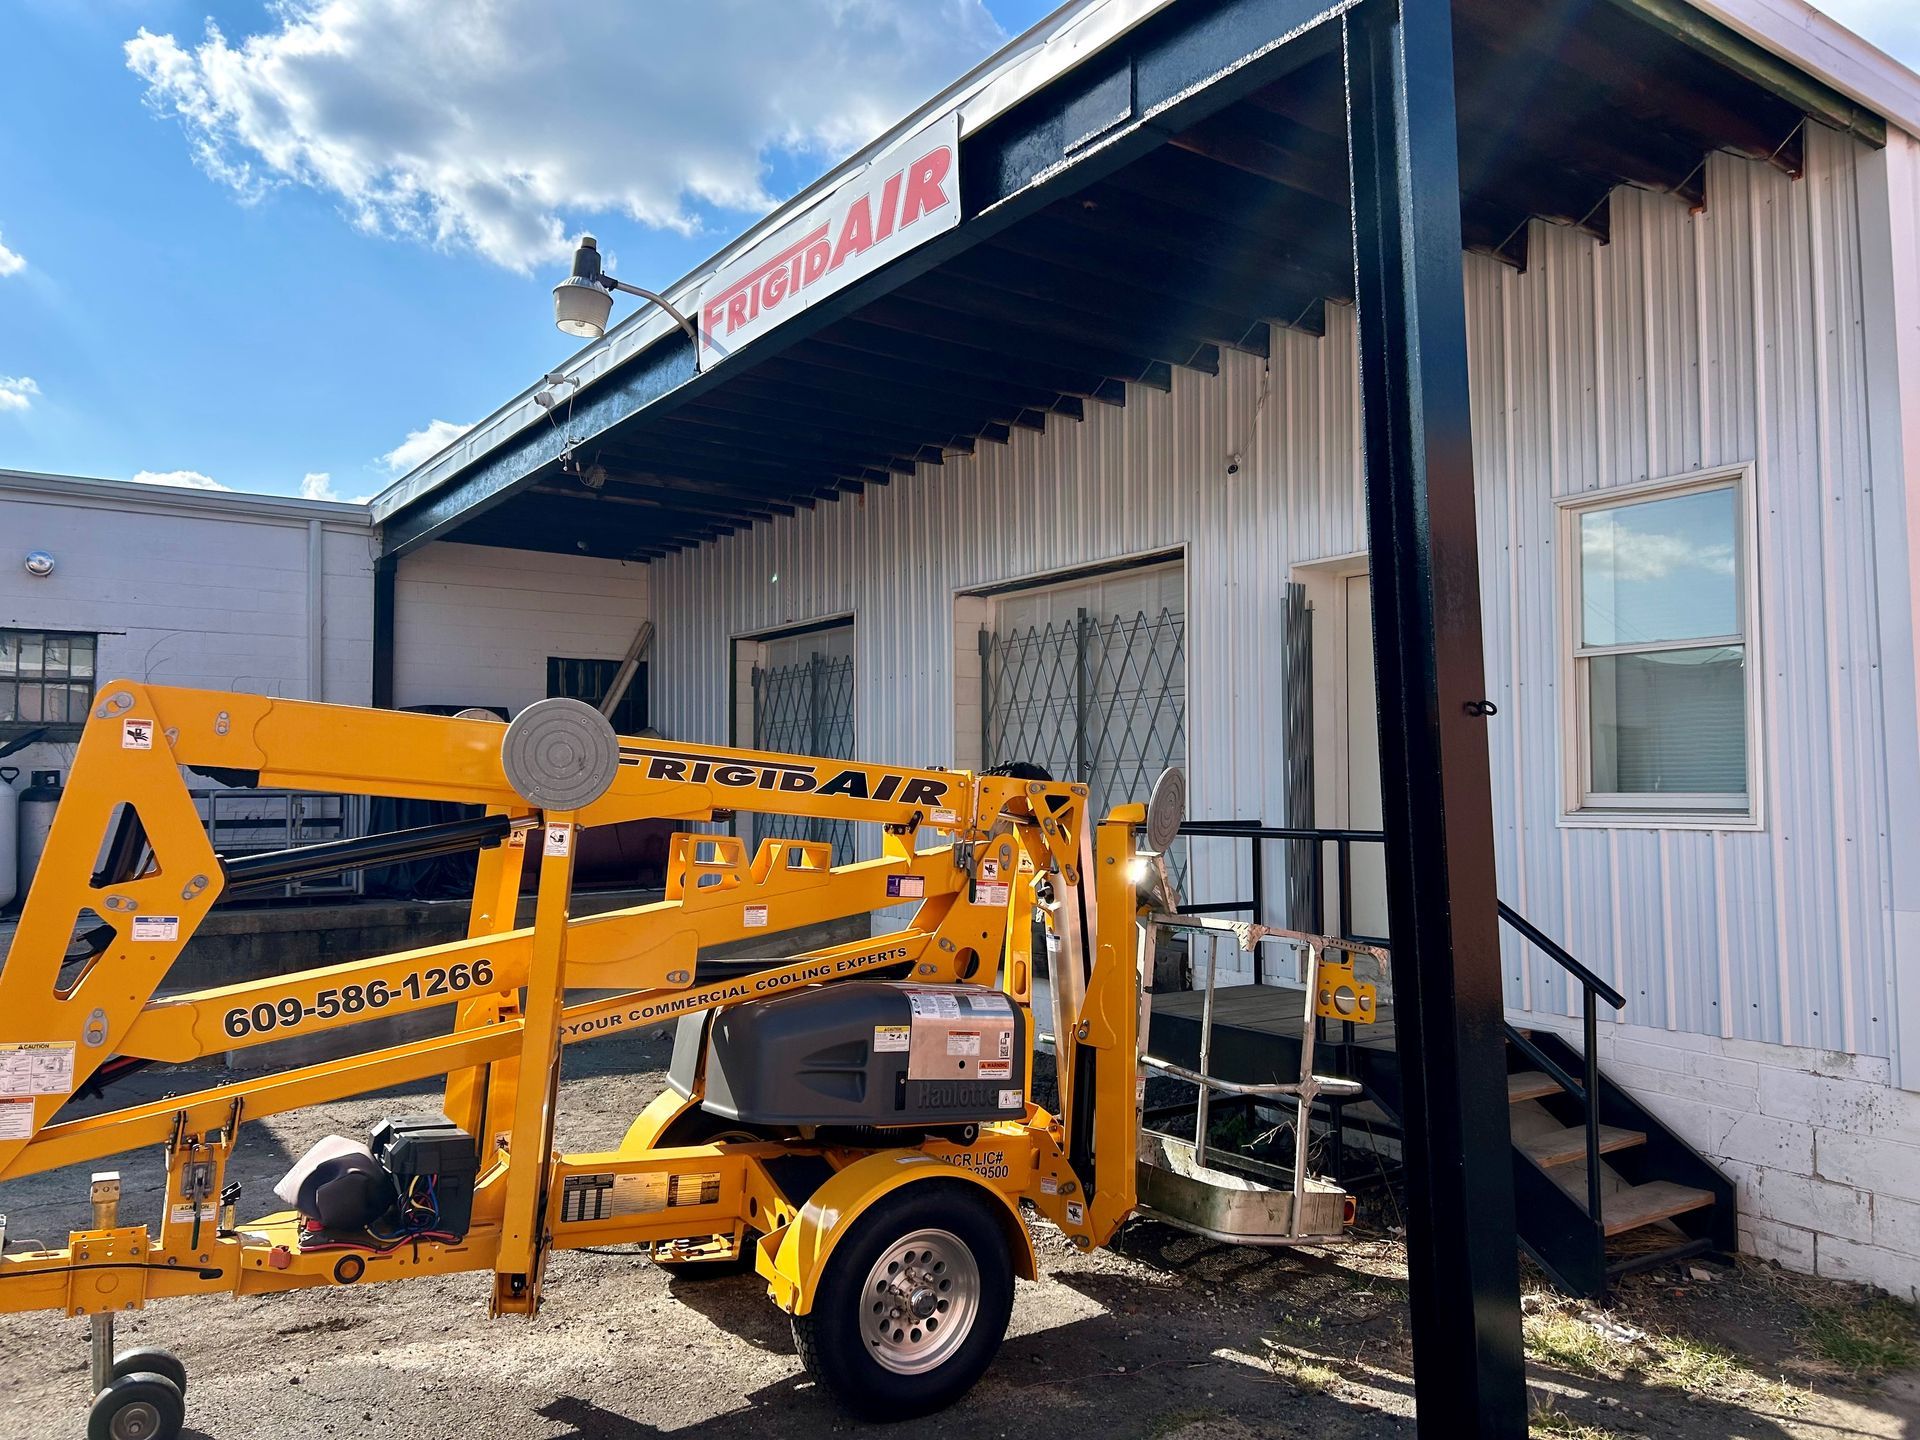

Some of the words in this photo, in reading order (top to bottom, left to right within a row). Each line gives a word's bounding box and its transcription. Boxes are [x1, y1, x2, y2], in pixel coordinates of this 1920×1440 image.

[702, 145, 952, 351] FRIGIDAIR
[224, 959, 494, 1039] 609-586-1266
[569, 1014, 623, 1035] YOUR
[628, 985, 750, 1021] COMMERCIAL
[755, 965, 831, 991] COOLING
[836, 947, 907, 973] EXPERTS
[918, 1082, 997, 1109] Haulotte
[941, 1153, 972, 1166] ACR
[975, 1151, 1004, 1165] LIC#
[967, 1165, 1009, 1179] 9500
